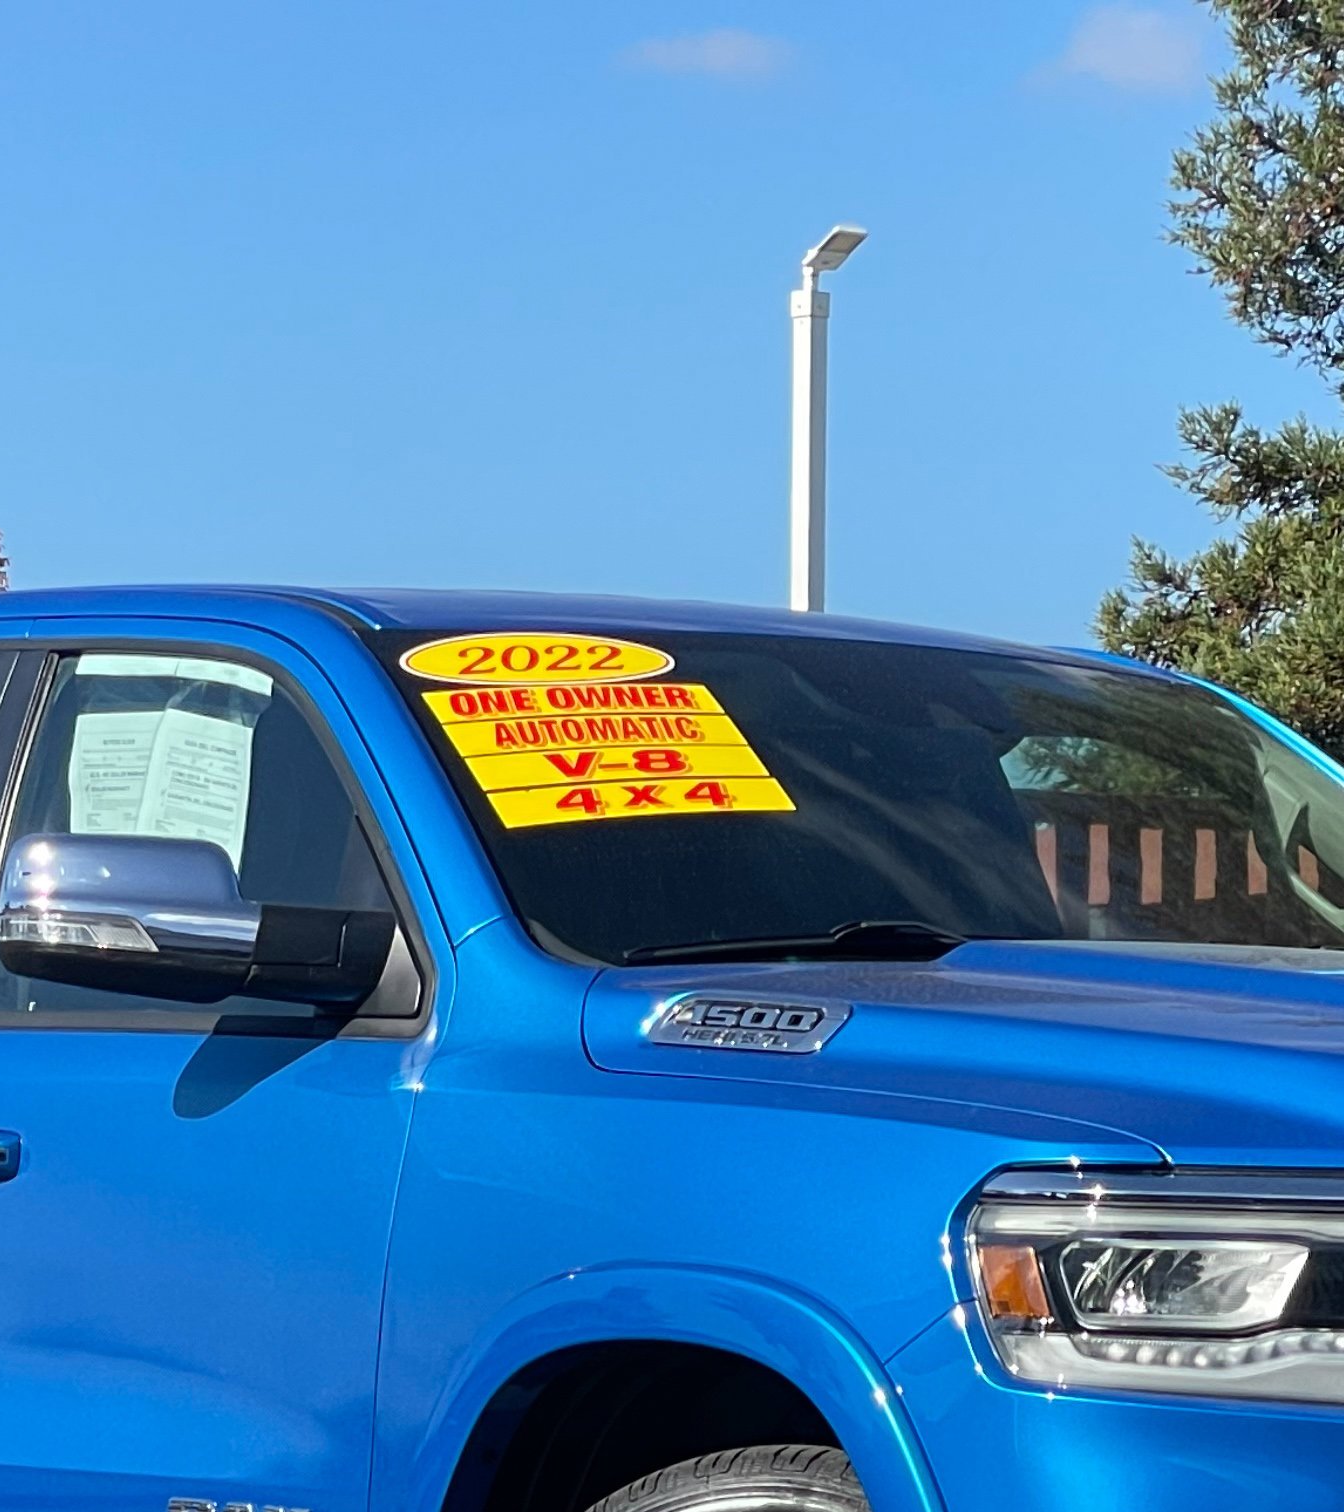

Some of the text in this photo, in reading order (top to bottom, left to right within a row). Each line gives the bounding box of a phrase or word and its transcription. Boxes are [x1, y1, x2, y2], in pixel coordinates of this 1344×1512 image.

[458, 645, 625, 675] 2022
[450, 686, 696, 717] ONE OWNER
[494, 716, 703, 749] AUTOMATIC
[544, 749, 692, 779] V-8
